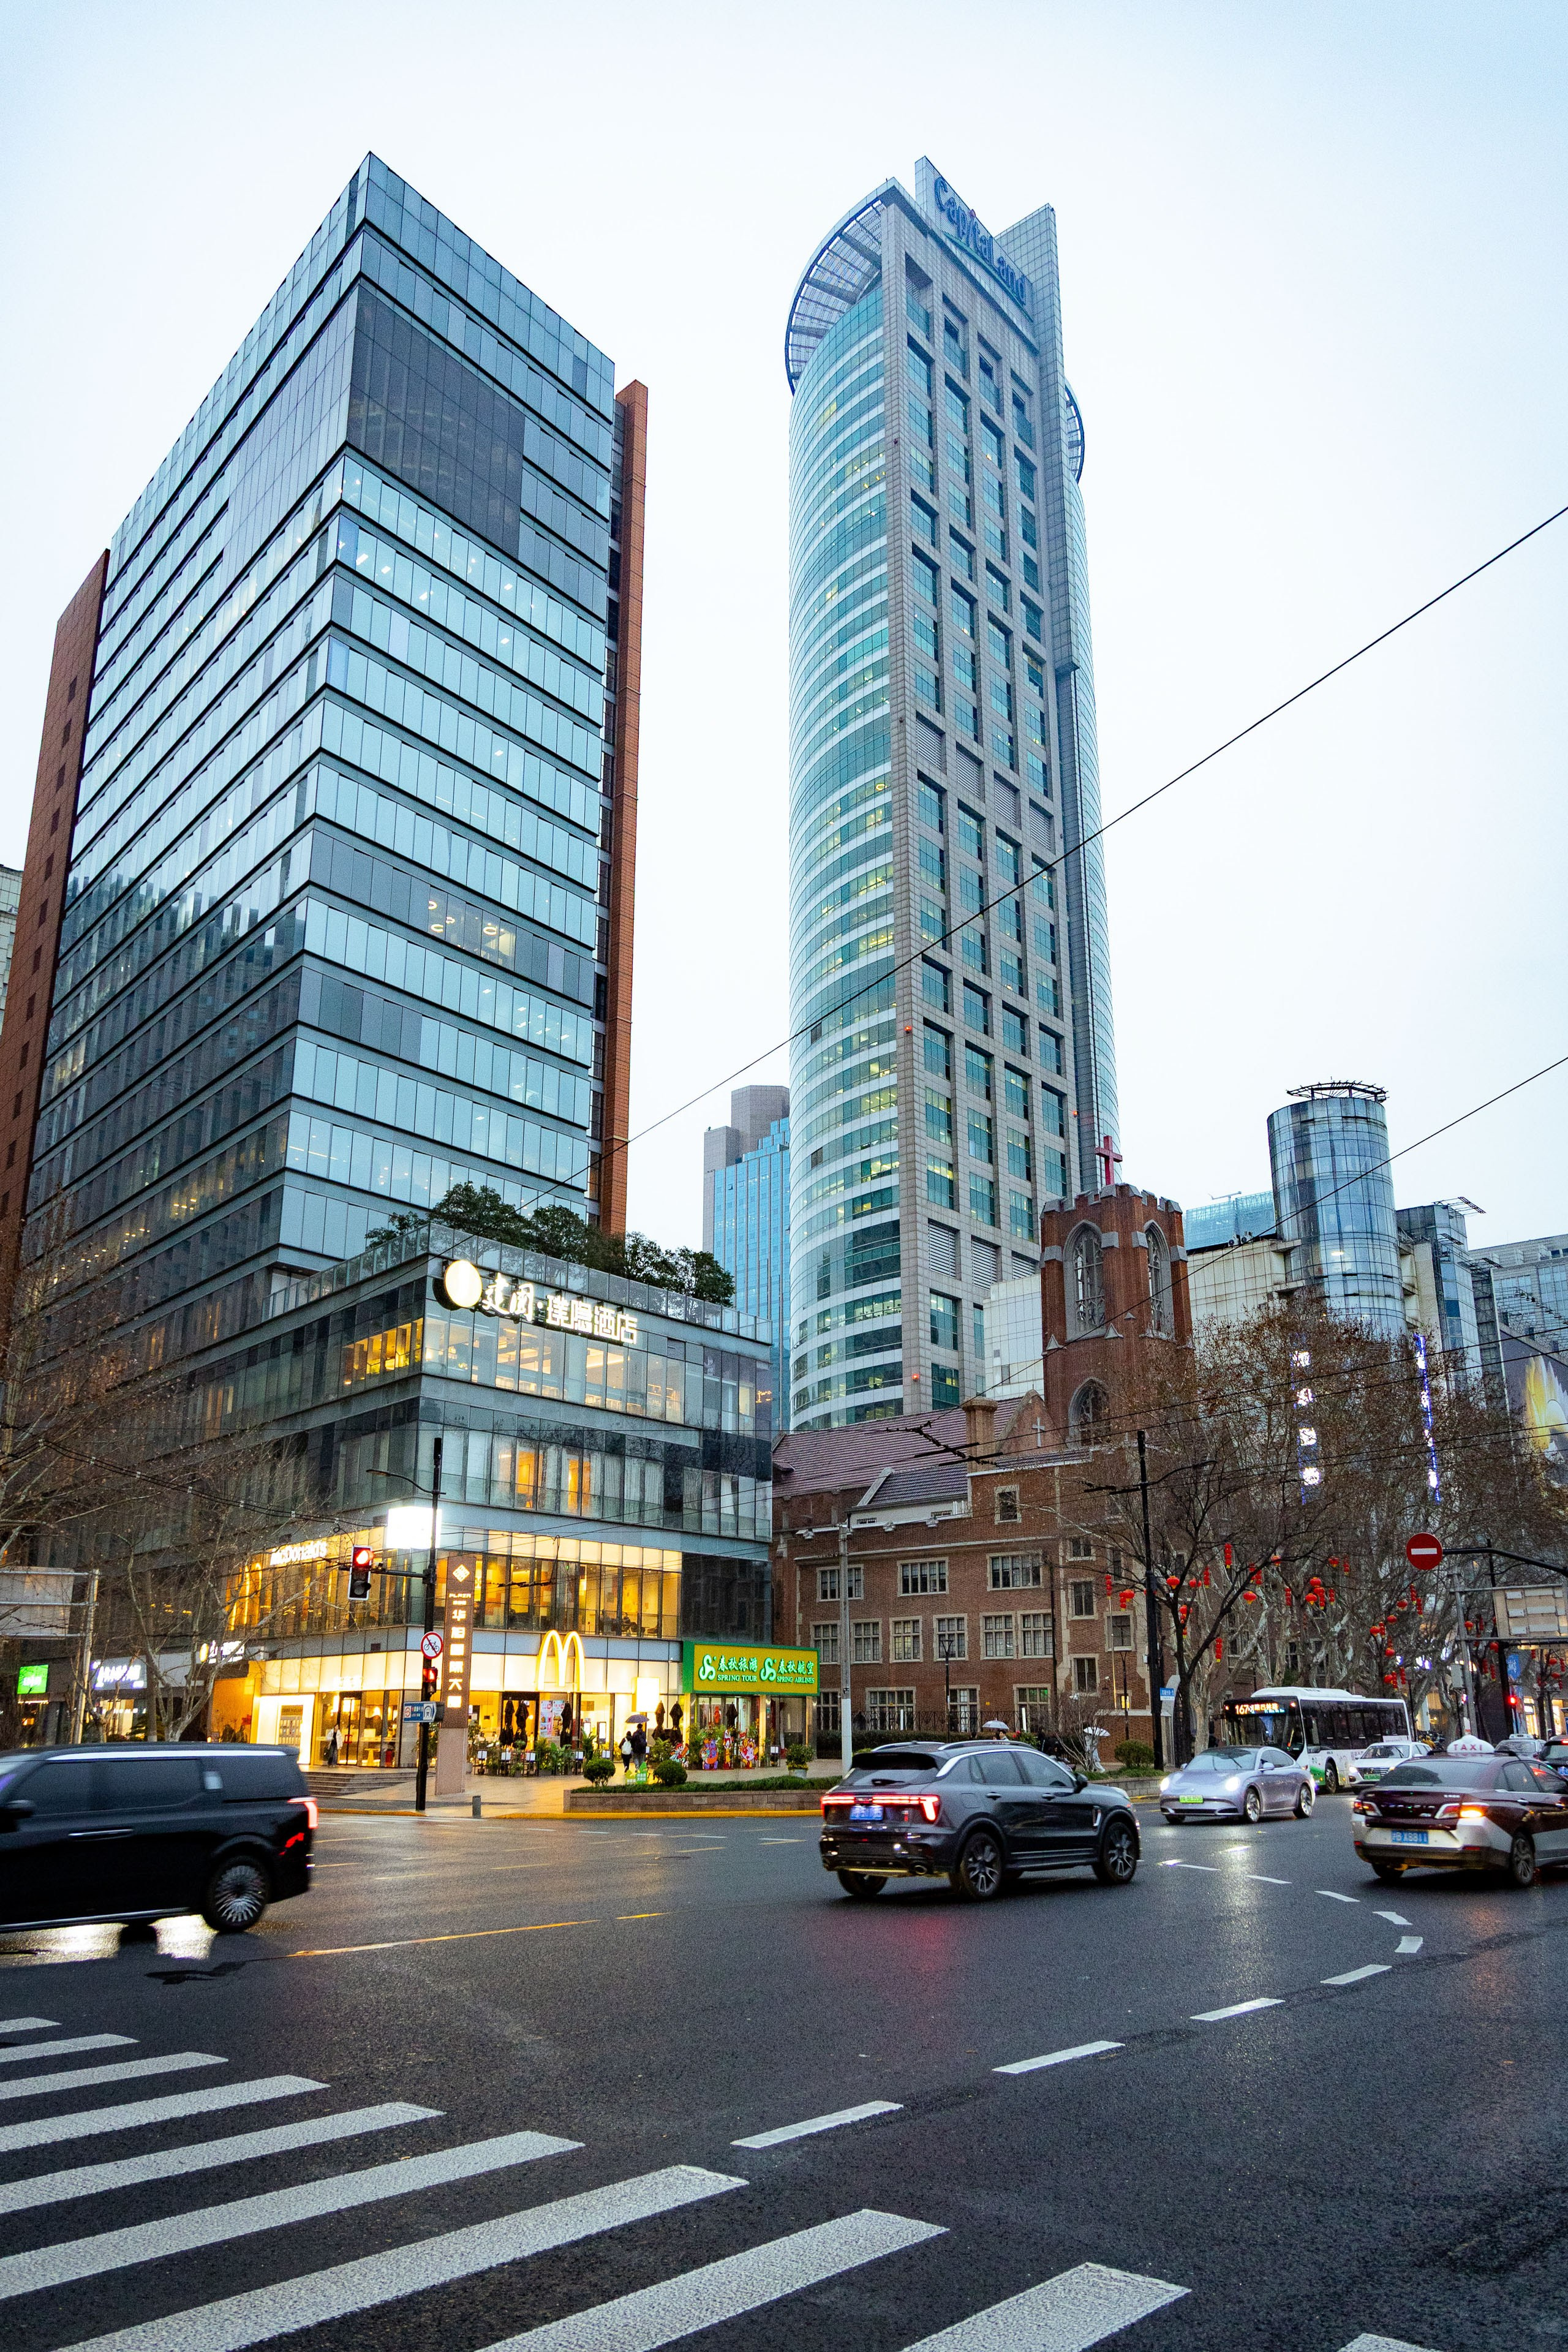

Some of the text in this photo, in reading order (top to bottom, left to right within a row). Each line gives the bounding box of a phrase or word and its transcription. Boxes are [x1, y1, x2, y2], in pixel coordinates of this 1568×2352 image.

[270, 1540, 328, 1566] McDonald's
[447, 1609, 467, 1708] 华旭际大
[718, 1655, 758, 1672] 春秋旅游
[778, 1658, 814, 1675] 春秋航空
[1235, 1704, 1250, 1714] 167
